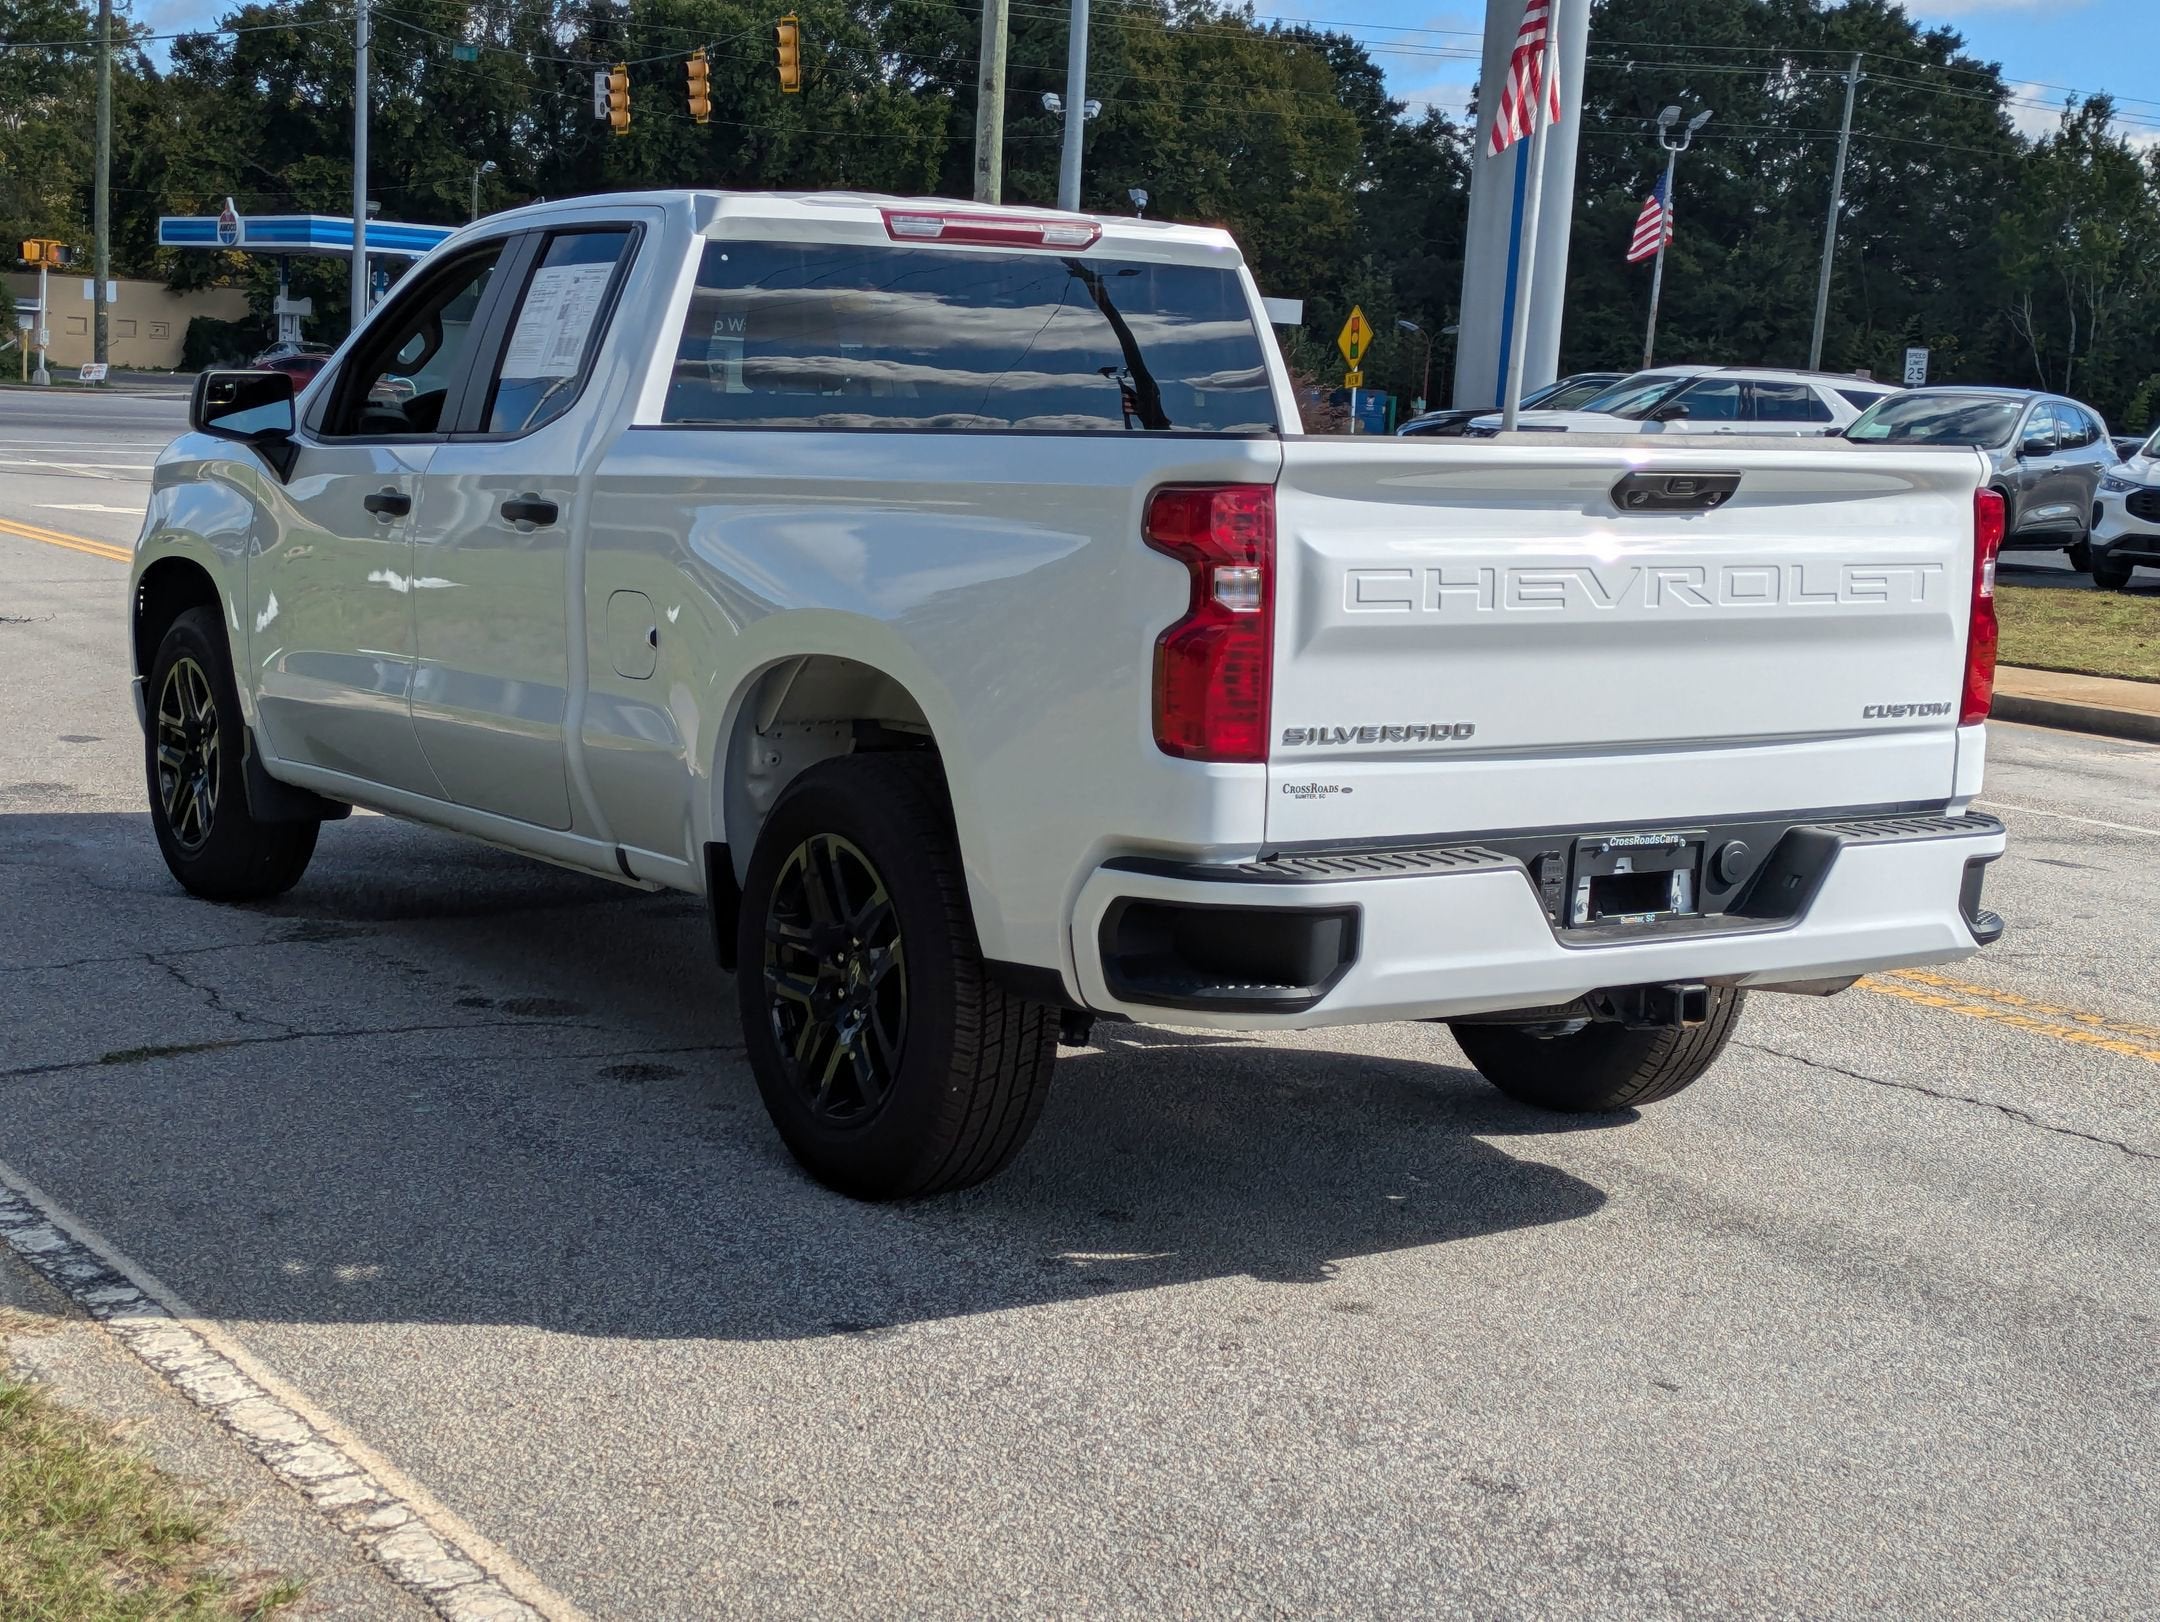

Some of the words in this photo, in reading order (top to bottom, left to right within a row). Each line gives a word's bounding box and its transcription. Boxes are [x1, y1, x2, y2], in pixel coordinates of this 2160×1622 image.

[1907, 367, 1925, 381] 25
[1343, 562, 1944, 613] CHEVROLET
[1862, 702, 1952, 719] CUSTOM
[1281, 723, 1476, 747] SILVERADO
[1609, 834, 1679, 847] CrossRoadsCars
[1645, 913, 1656, 922] SC
